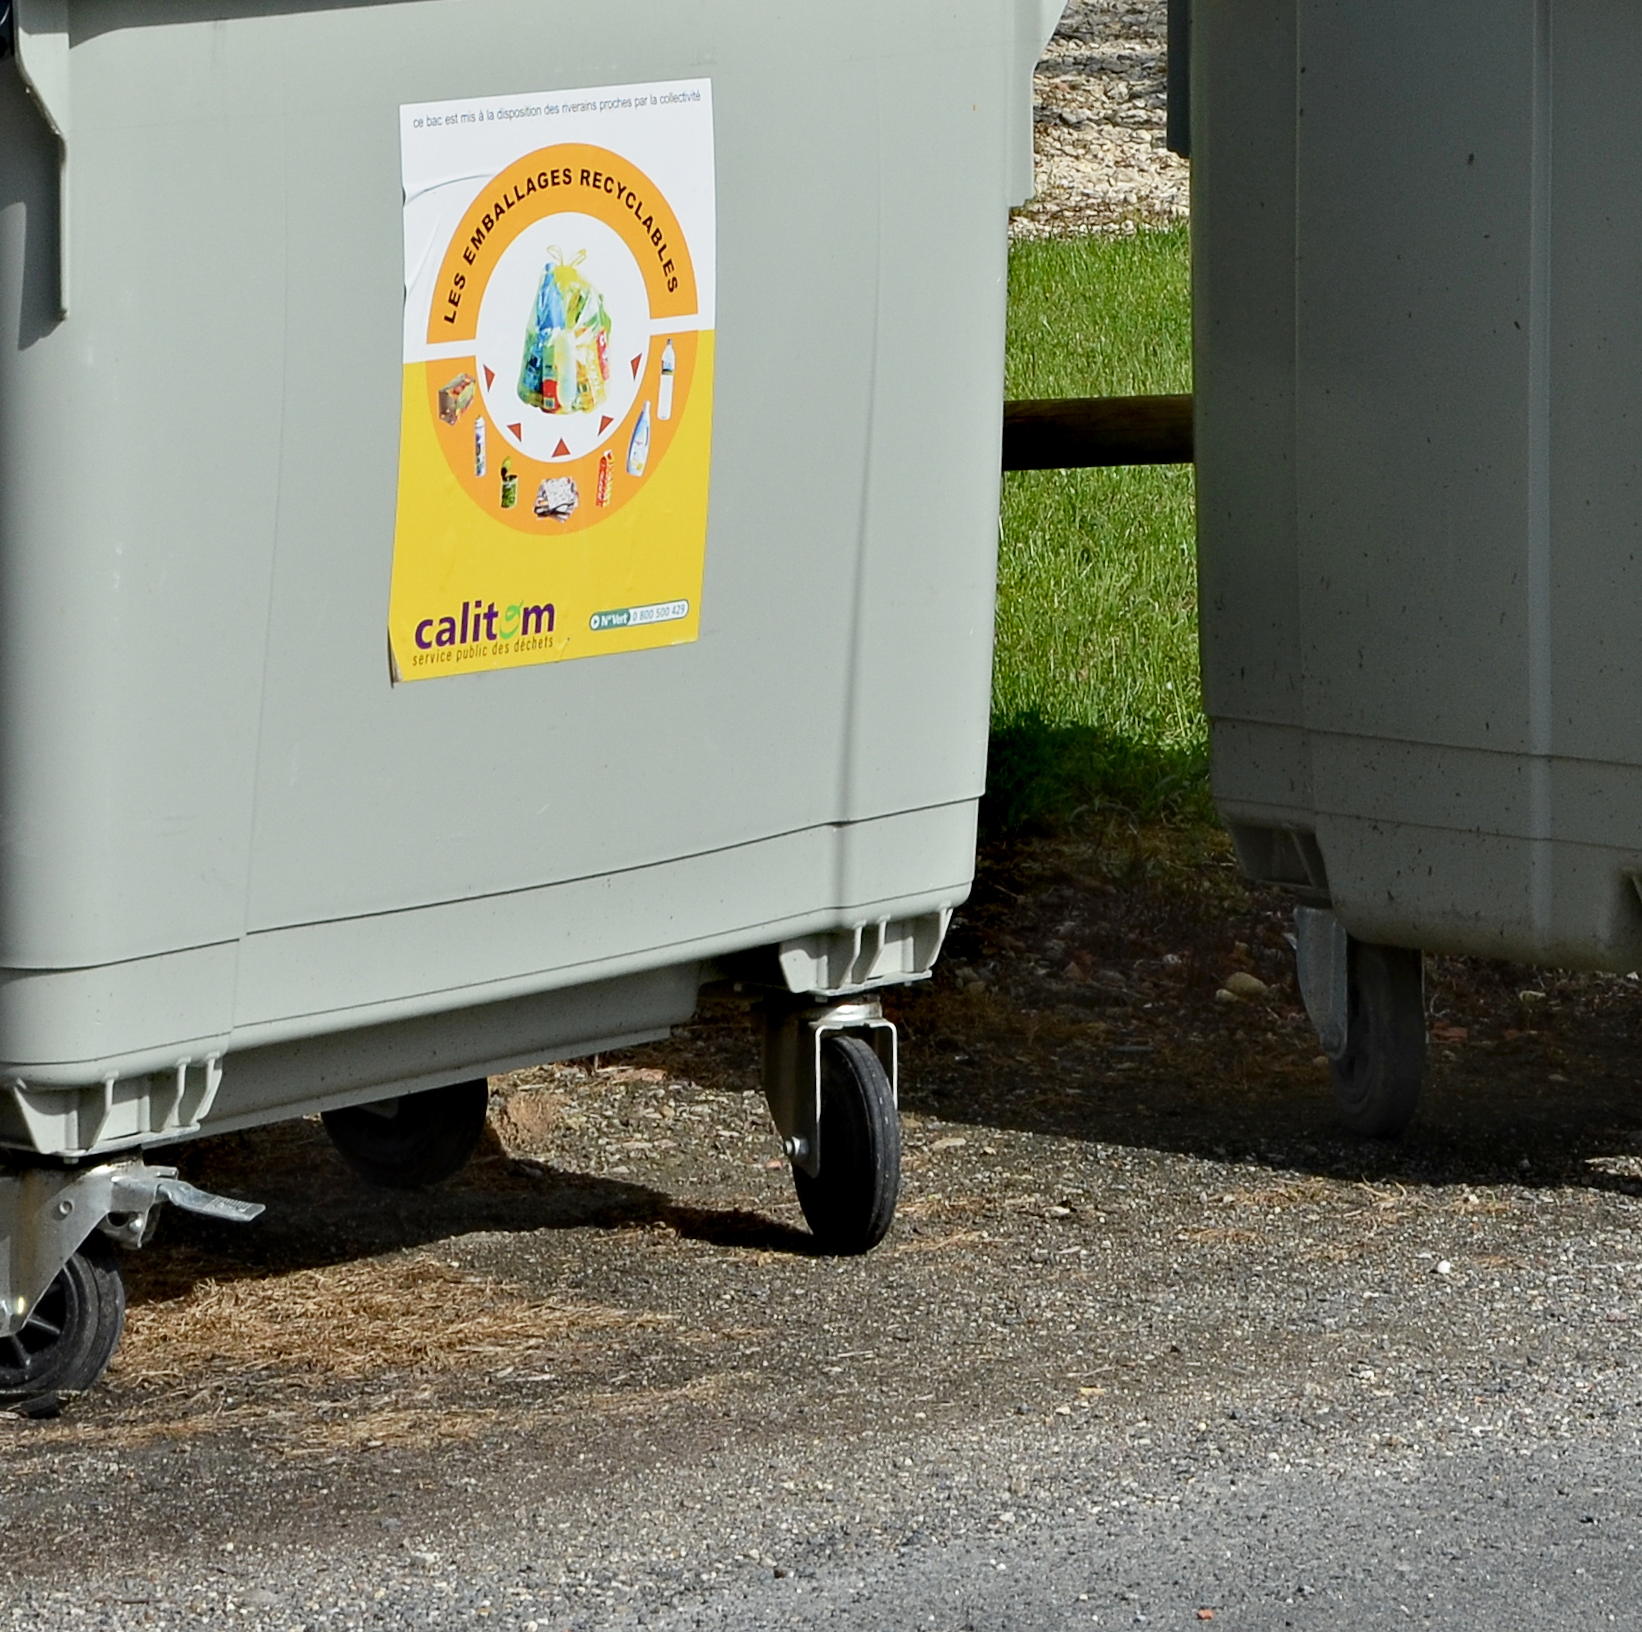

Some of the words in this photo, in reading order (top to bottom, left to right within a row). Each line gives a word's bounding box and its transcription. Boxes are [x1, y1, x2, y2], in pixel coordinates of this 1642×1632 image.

[413, 118, 424, 128] ce
[426, 115, 443, 127] bac
[445, 114, 458, 125] est
[461, 111, 476, 123] mis
[478, 110, 484, 121] à
[487, 109, 495, 120] la
[497, 106, 542, 121] disposition
[544, 104, 560, 115] des
[562, 100, 597, 113] riverains
[599, 97, 632, 112] proches
[634, 96, 648, 108] par
[650, 94, 658, 105] la
[660, 90, 701, 104] collectivité
[443, 272, 467, 324] LES
[462, 168, 573, 266] EMBALLAGES
[579, 168, 679, 293] RECYCLABLES
[412, 649, 452, 666] service
[456, 643, 488, 662] public
[491, 641, 510, 655] des
[514, 636, 554, 652] déchets
